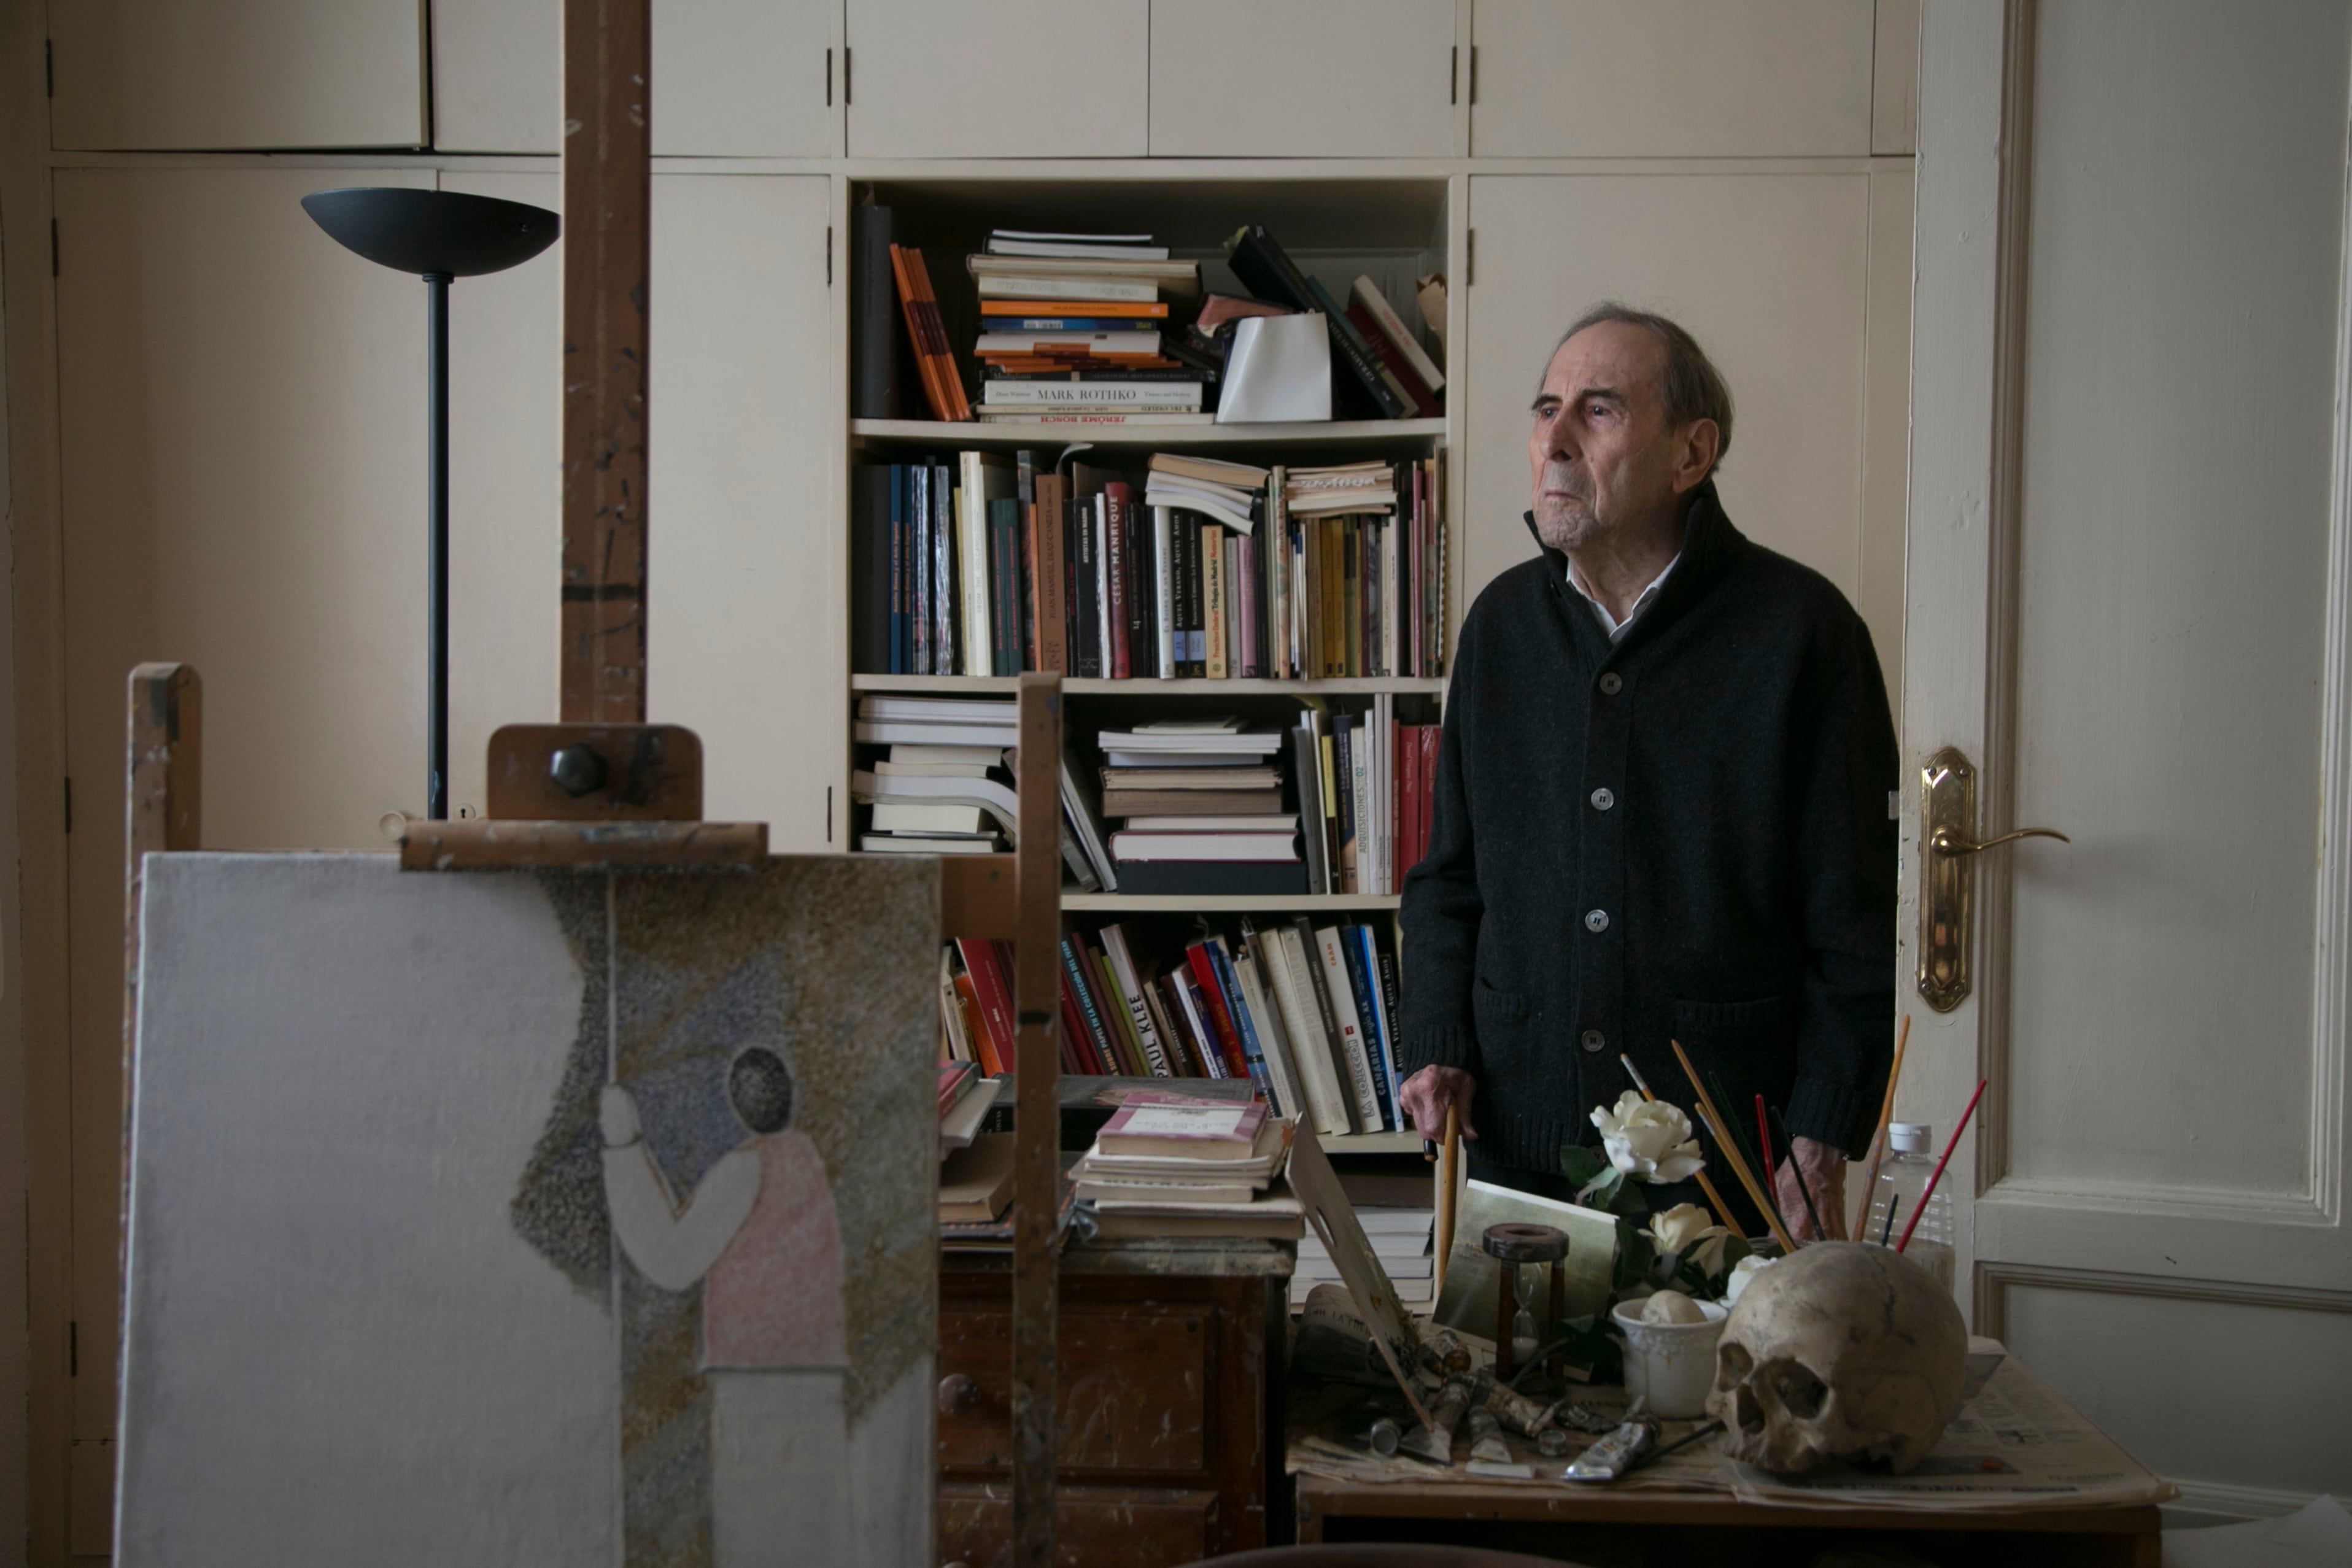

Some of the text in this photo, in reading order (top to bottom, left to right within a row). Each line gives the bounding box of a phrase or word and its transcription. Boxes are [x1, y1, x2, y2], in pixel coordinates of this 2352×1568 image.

[1345, 346, 1376, 382] GERARDO
[1038, 389, 1073, 400] MARK
[1080, 389, 1137, 400] ROTHKO
[1108, 495, 1121, 605] CÉSAR MANRIQUE
[1326, 943, 1336, 967] CAAM
[1381, 958, 1391, 979] AMOR
[1059, 940, 1117, 1071] SOBRE PAPEL EN LA COLECCIÓN DEL IVAM
[1385, 983, 1396, 1006] AQUEL
[1129, 994, 1168, 1078] PAUL KLEE
[1387, 1009, 1401, 1041] VERANO,
[1178, 1048, 1187, 1062] JUAN
[1361, 999, 1385, 1096] CANARIAS siglo XX
[1393, 1044, 1405, 1069] AQUEL
[1251, 1054, 1266, 1088] MUNICIPAL
[1345, 1038, 1375, 1119] LA COLECCIÓN
